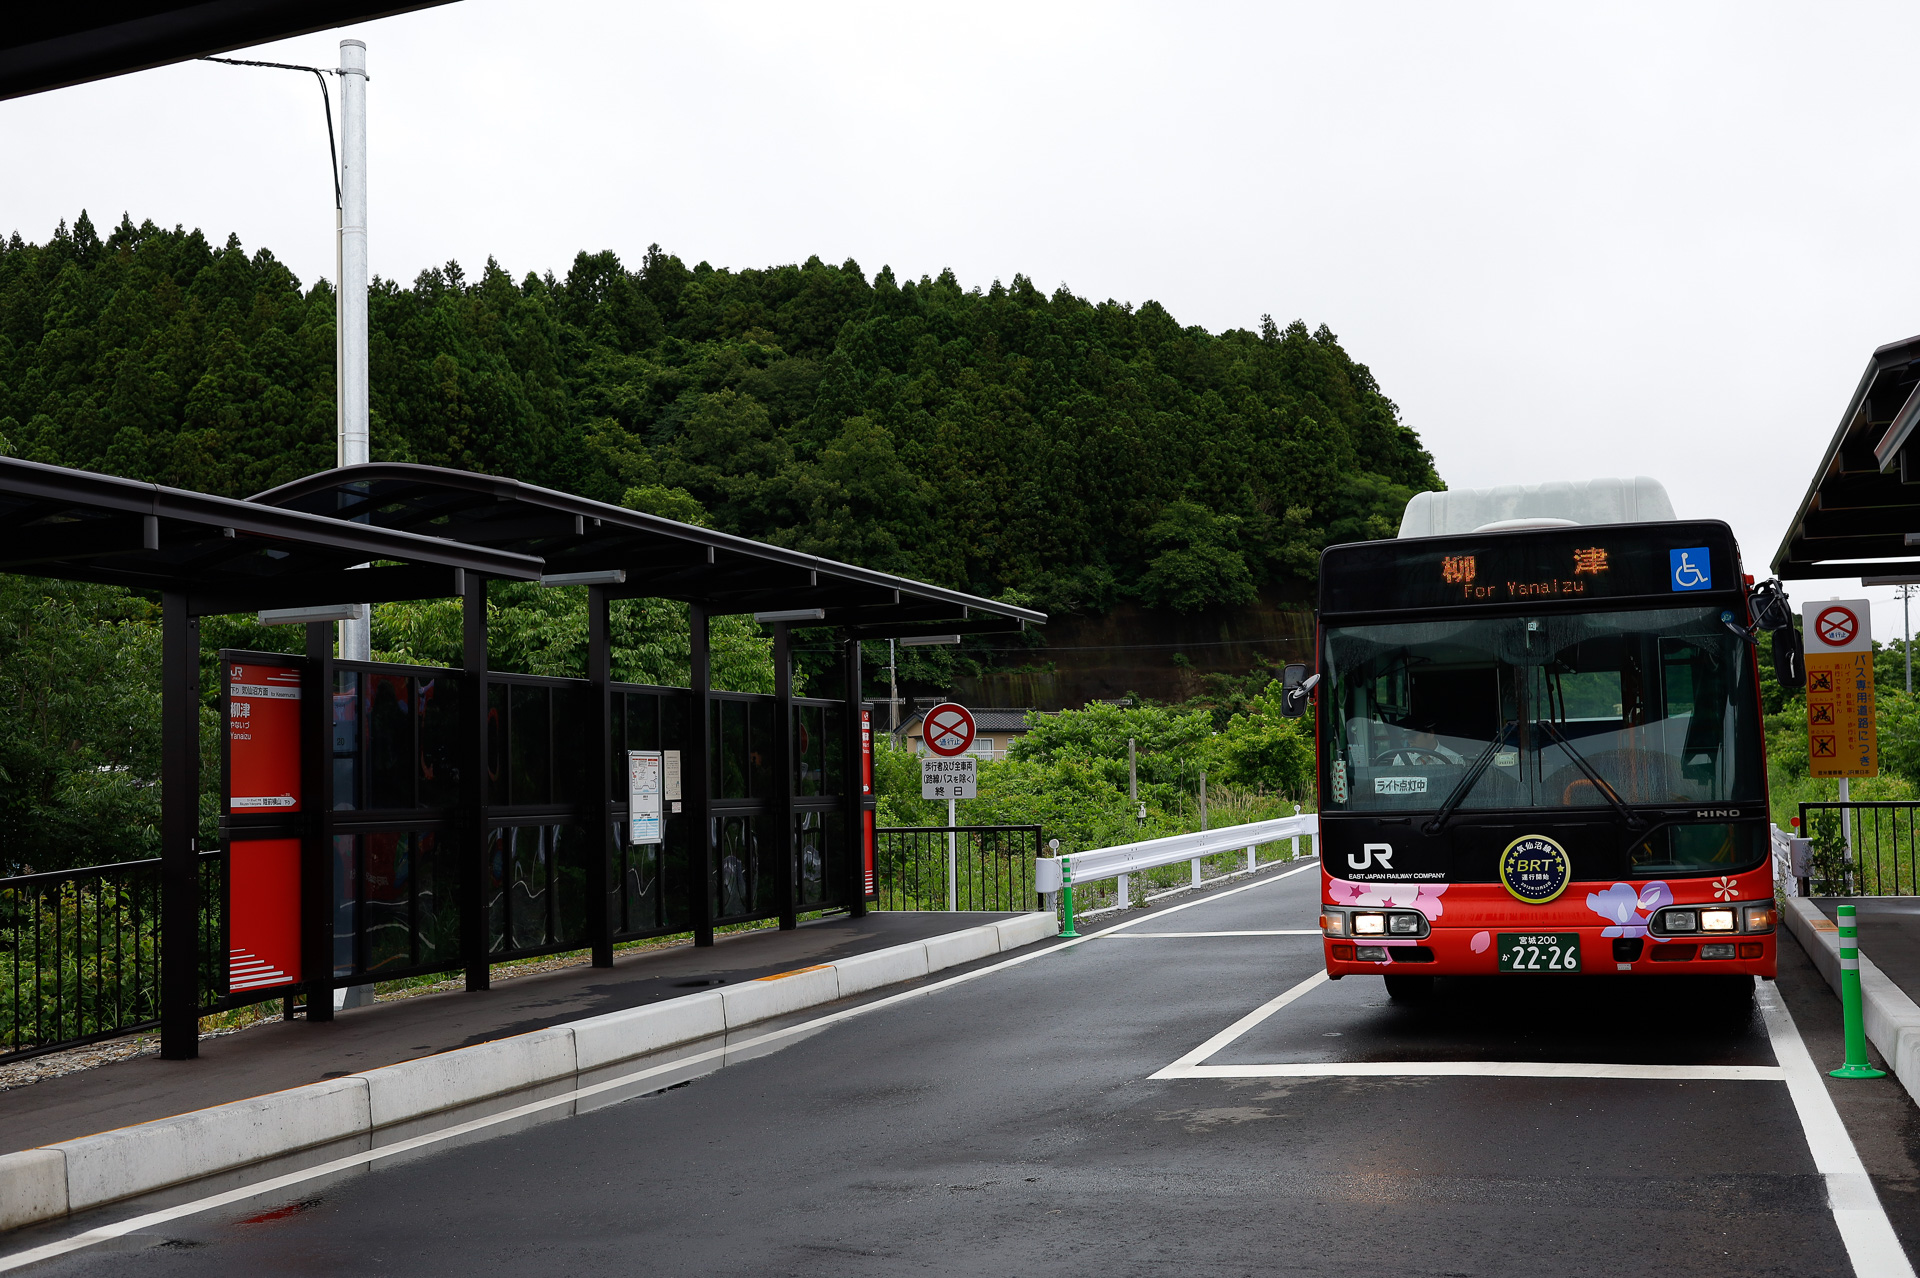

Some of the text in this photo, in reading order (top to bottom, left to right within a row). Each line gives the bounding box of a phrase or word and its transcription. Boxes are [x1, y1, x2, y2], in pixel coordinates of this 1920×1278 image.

[1464, 579, 1585, 598] For Yanaizu
[230, 666, 243, 677] JR
[230, 702, 251, 718] 柳津
[1855, 655, 1870, 767] バス専用道路につき
[940, 738, 960, 746] 通行止
[925, 761, 973, 772] 歩行者及び全車両
[924, 773, 975, 784] (路線バスを除く)
[1377, 780, 1425, 792] ライト点灯中
[1697, 809, 1740, 817] HINO
[1516, 841, 1552, 854] 気仙沼線
[1347, 843, 1394, 870] JR
[1517, 859, 1554, 872] BRT
[1521, 873, 1550, 881] 運行開始
[1501, 945, 1577, 970] か 22-26
